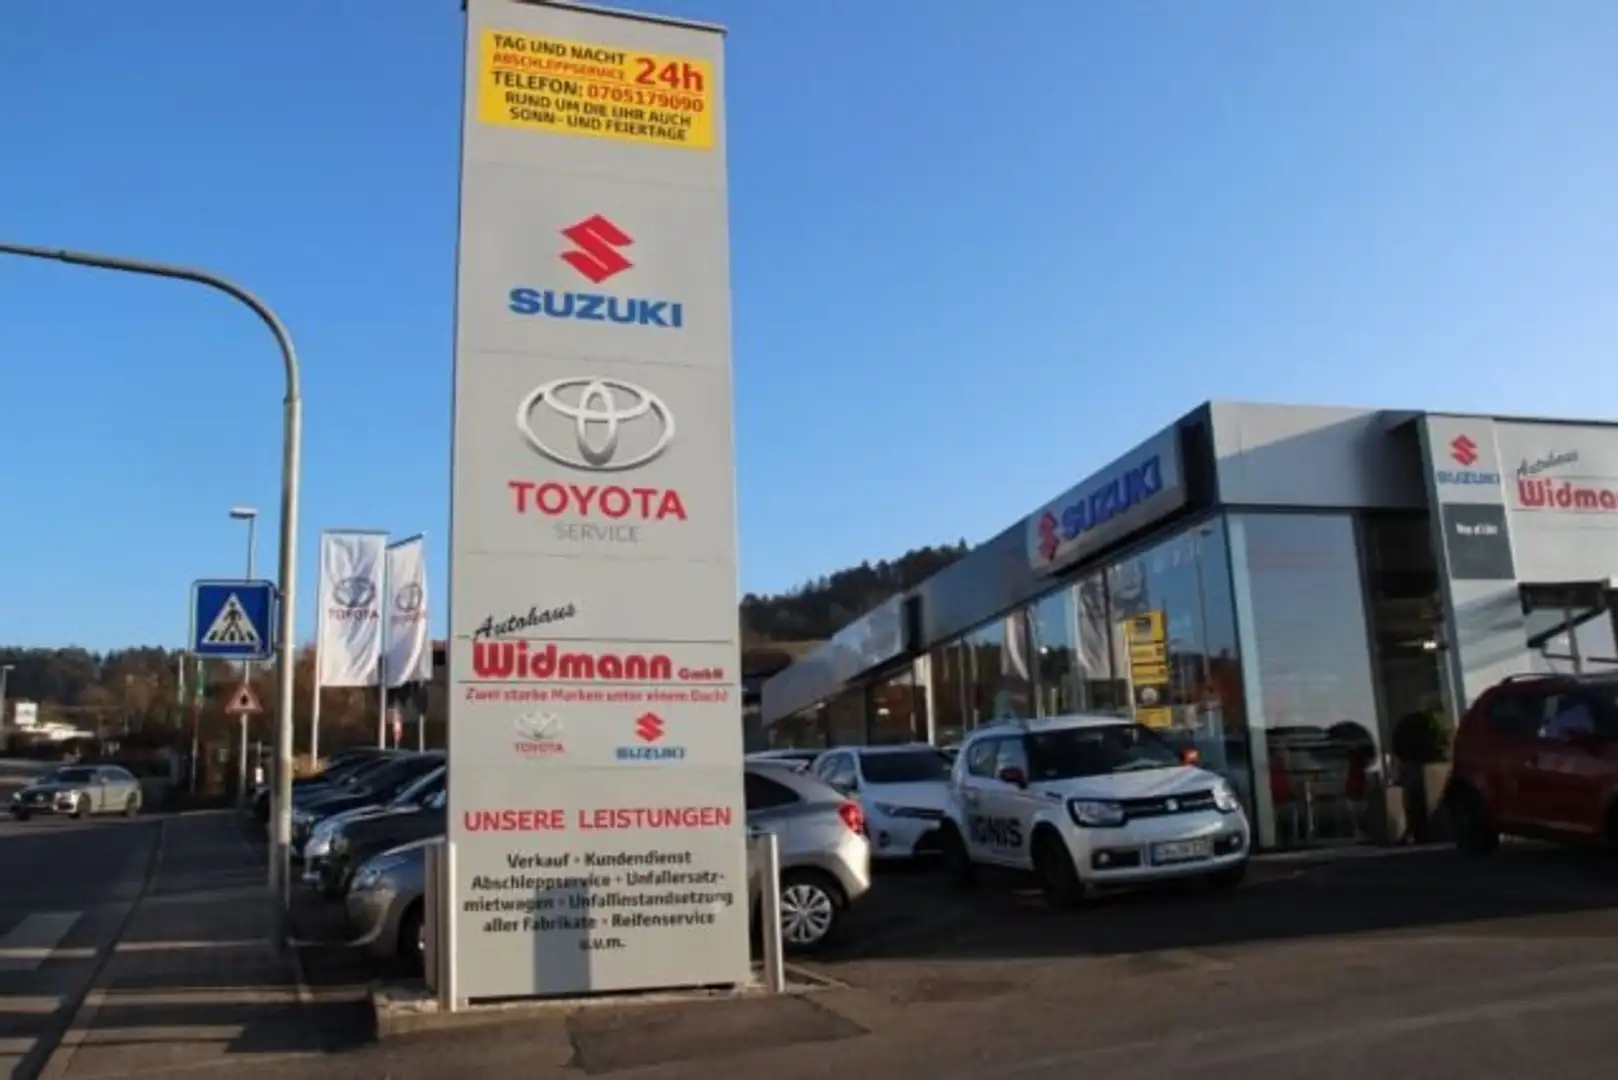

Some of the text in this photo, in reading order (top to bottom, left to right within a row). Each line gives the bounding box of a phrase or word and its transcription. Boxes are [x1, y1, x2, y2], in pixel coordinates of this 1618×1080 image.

[493, 52, 626, 80] ABSCHLEPPSERVICE
[494, 34, 705, 92] TAG UND NACHT 24h
[492, 70, 705, 112] TELEFON: 0705179090
[505, 90, 692, 126] RUND UM DIE UHR AUCH
[566, 115, 602, 132] UND
[604, 119, 687, 142] FEIERTAGE
[508, 287, 683, 328] SUZUKI
[1436, 470, 1500, 485] SUZUKI
[508, 479, 688, 521] TOYOTA
[1060, 455, 1163, 540] SUZUKI
[553, 522, 640, 543] SERVICE
[327, 607, 379, 622] TOYOTA
[473, 602, 577, 641] Autohaus
[473, 640, 672, 680] Widmann
[465, 687, 501, 701] Zwei
[503, 688, 547, 701] starke
[550, 687, 604, 701] Marken
[646, 690, 688, 702] einem
[514, 741, 565, 754] TOYOTA
[616, 746, 685, 760] SUZUKI
[464, 806, 732, 831] UNSERE LEISTUNGEN
[507, 850, 692, 869] Verkauf Kundendienst
[470, 870, 725, 892] Abschleppservice Unfallersatz-
[463, 890, 734, 914] mietwagen Unfallinstandsetzung
[482, 912, 716, 933] aller Fabrikate Reifenservice
[579, 936, 627, 951] u.v.m.
